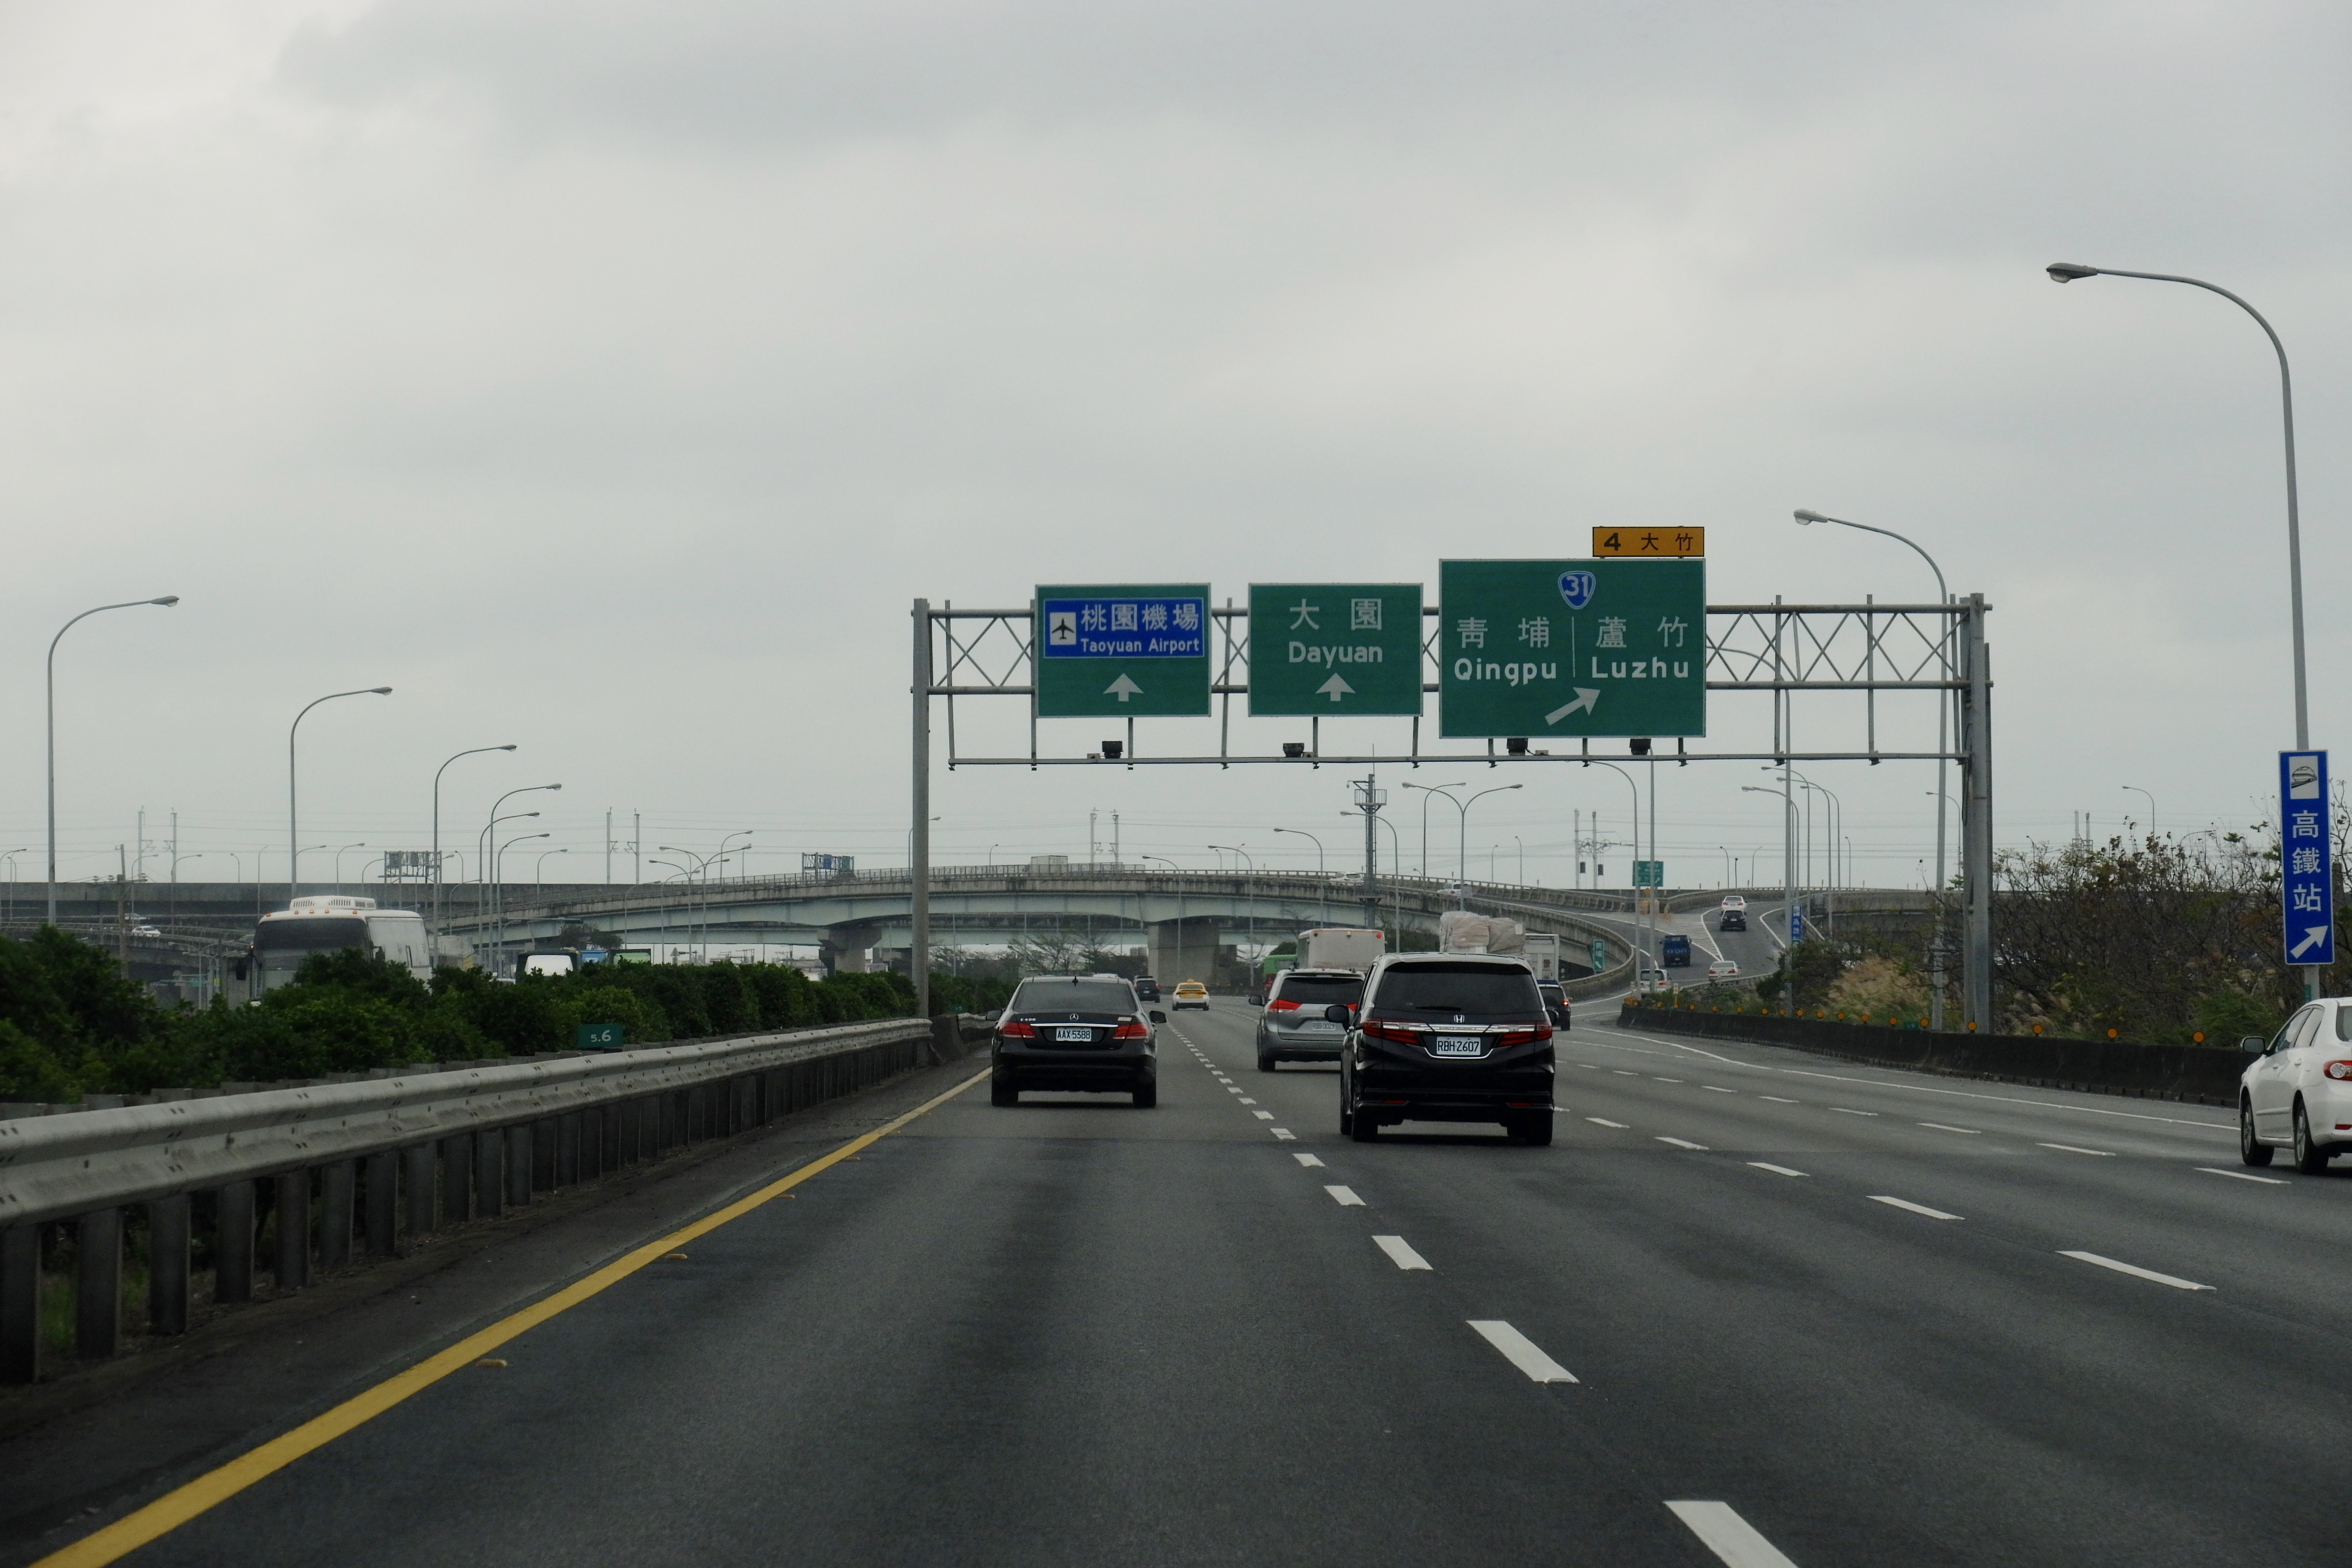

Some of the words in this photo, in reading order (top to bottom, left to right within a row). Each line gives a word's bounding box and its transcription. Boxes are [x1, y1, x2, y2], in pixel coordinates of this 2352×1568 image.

[1604, 533, 1621, 551] 4
[1641, 532, 1693, 551] 大竹
[1564, 575, 1588, 597] 31
[1081, 603, 1199, 632] 桃園機場
[1289, 599, 1382, 630] 大園
[1596, 616, 1688, 648] 蘆竹
[1081, 638, 1142, 655] Taoyuan
[1149, 638, 1200, 654] Airport
[1289, 641, 1383, 669] Dayuan
[1455, 658, 1556, 686] Qingpu
[1592, 657, 1688, 678] Luzhu
[2292, 809, 2322, 912] 高鐵站
[591, 1030, 612, 1042] 5.6
[1057, 1030, 1090, 1039] AAX-5388
[1438, 1041, 1479, 1052] RBH-2607
